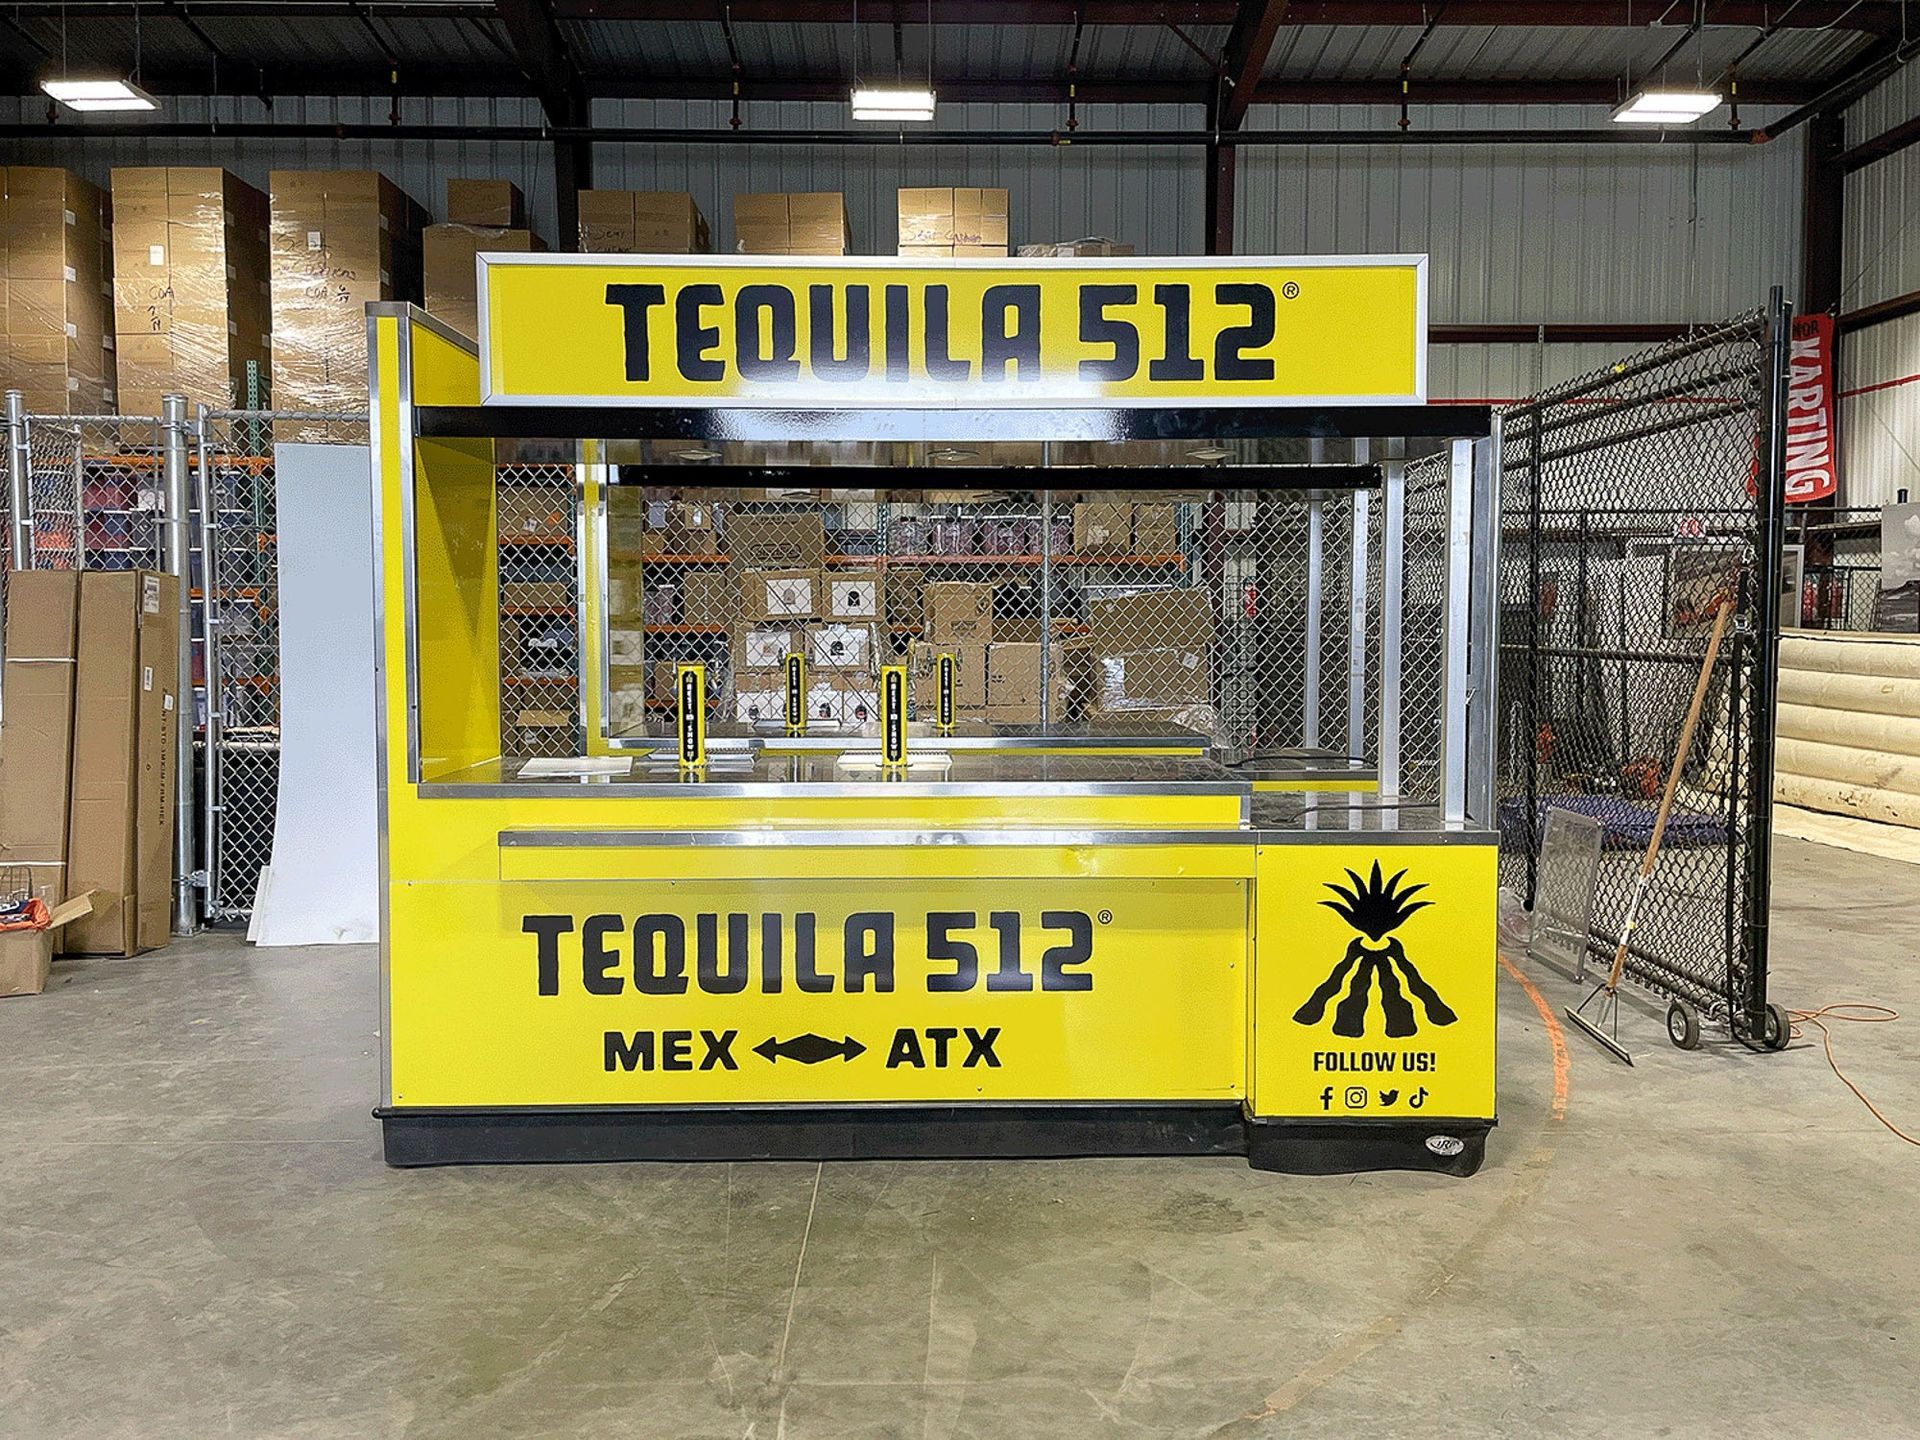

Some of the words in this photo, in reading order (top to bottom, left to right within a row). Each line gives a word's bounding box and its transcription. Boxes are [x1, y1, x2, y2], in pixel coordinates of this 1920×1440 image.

[605, 284, 1042, 382] TEQUILA
[522, 912, 895, 997] TEQUILA
[605, 1030, 739, 1072] MEX
[886, 1027, 1002, 1069] ATX
[1314, 1051, 1397, 1072] FOLLOW
[1402, 1052, 1436, 1072] US!
